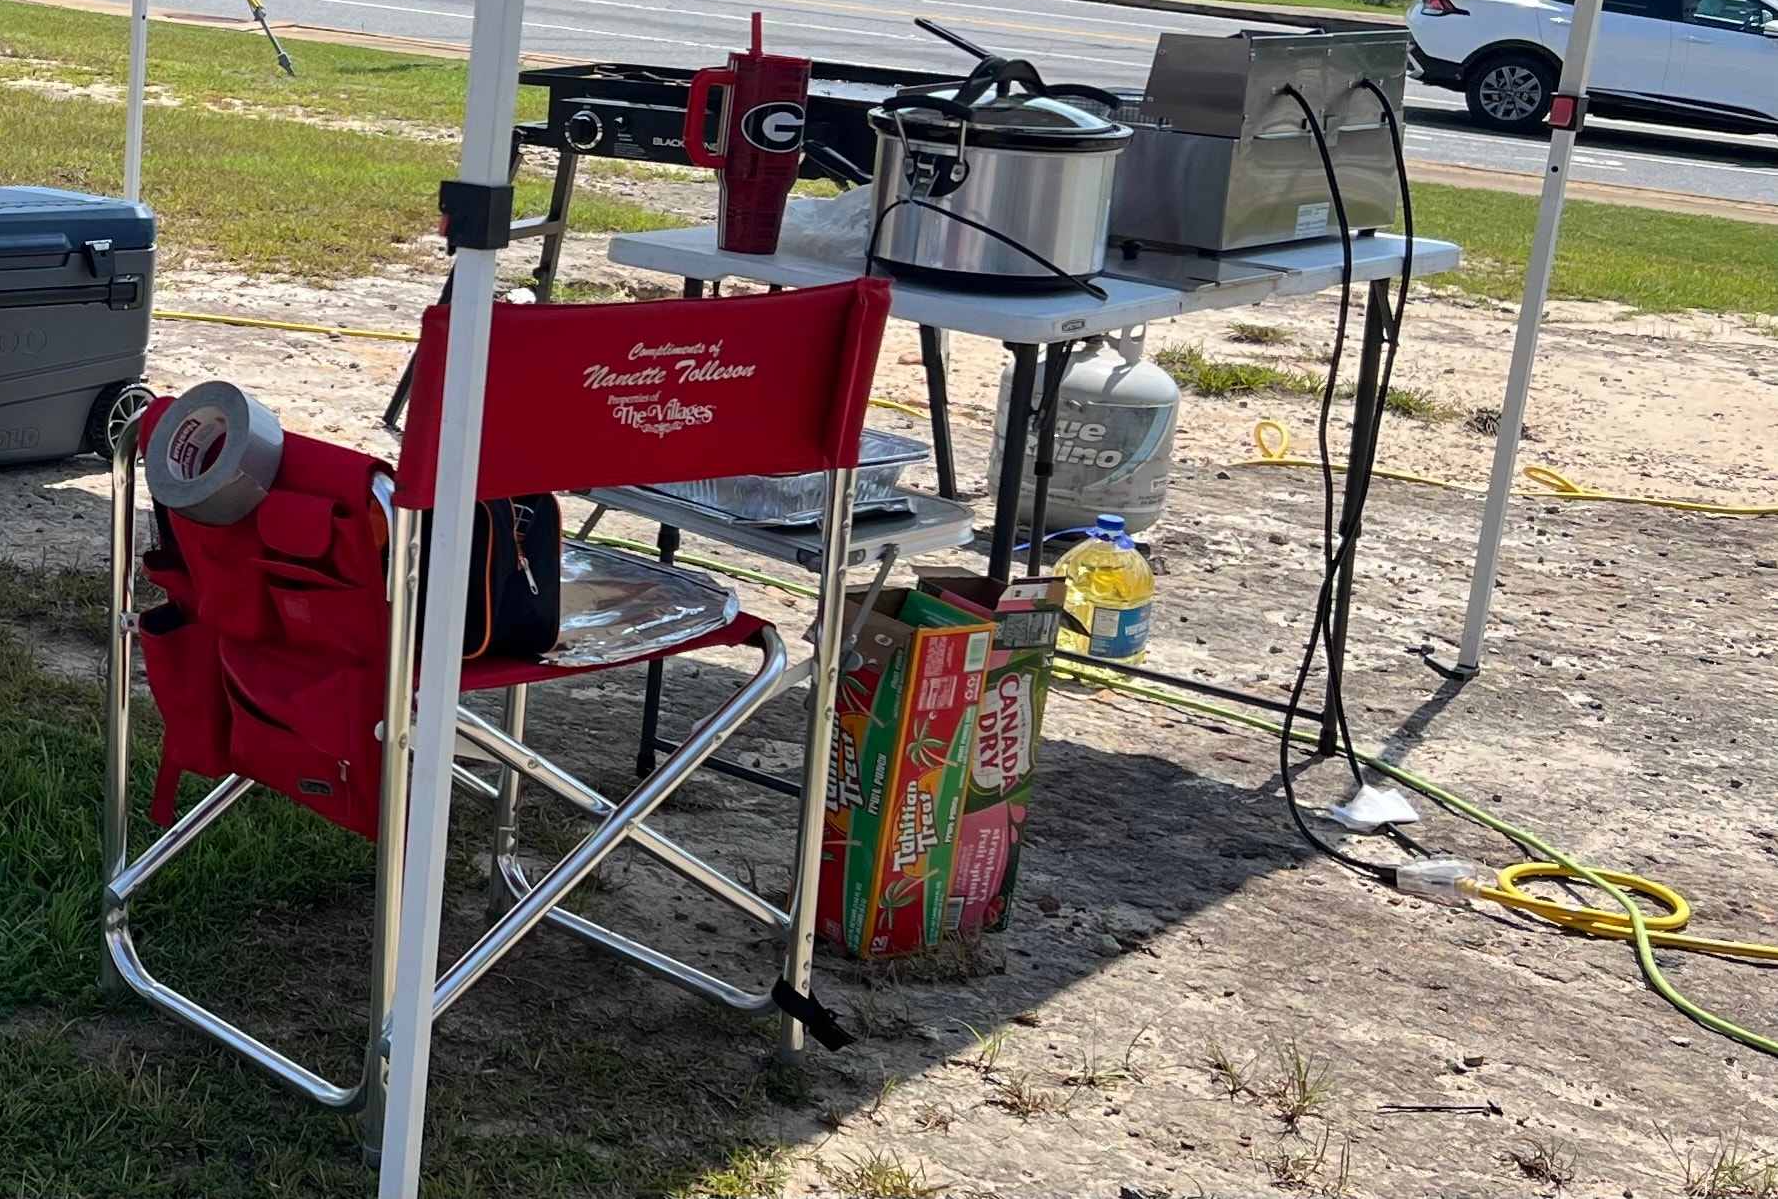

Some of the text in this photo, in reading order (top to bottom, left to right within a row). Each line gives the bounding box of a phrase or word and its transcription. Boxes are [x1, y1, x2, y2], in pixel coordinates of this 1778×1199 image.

[583, 359, 757, 389] Nanette Tolleson
[627, 339, 723, 360] Compliments of
[172, 420, 199, 460] Nashua
[613, 398, 713, 429] The Villages
[978, 711, 999, 768] DRY
[998, 672, 1020, 795] CANADA
[838, 732, 864, 808] Treat
[892, 780, 918, 872] Tahitian
[916, 792, 939, 853] Treat
[965, 829, 992, 905] fruit splash
[980, 828, 1001, 902] strawberry
[870, 935, 890, 954] 12
